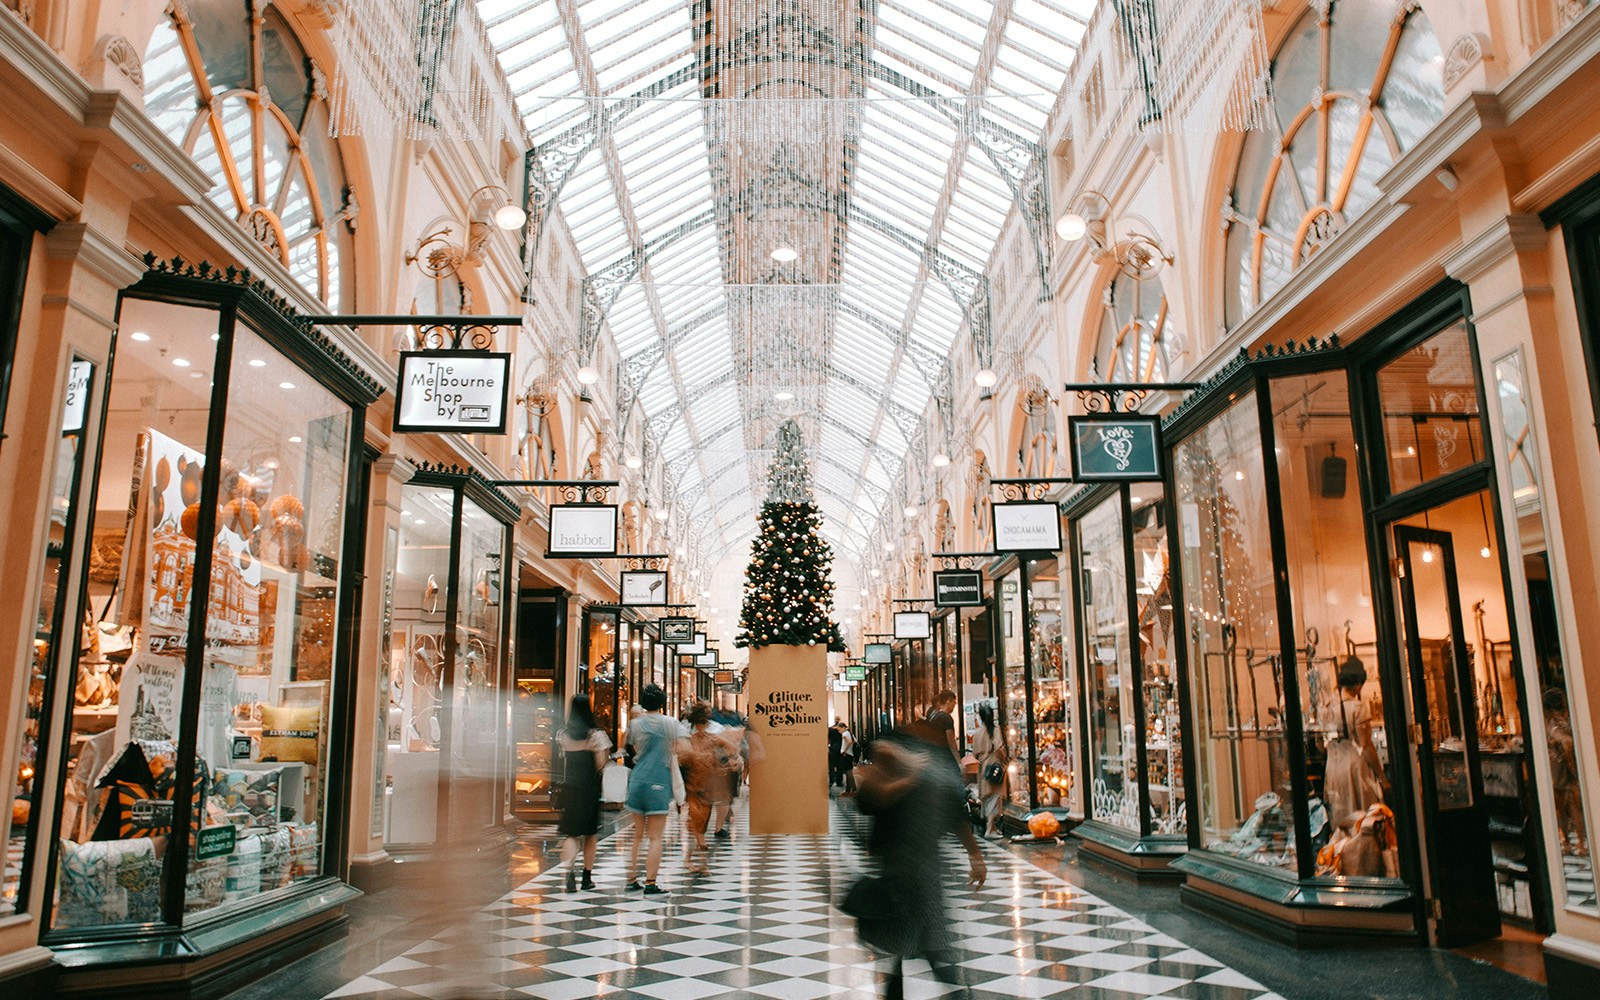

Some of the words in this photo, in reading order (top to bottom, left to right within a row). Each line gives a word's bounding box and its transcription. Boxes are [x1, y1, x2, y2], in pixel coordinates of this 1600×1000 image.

[428, 362, 454, 375] The
[411, 373, 495, 388] Melbourne
[424, 388, 463, 406] Shop
[437, 404, 456, 419] by
[1003, 526, 1048, 535] CHOCAMAMA
[939, 584, 978, 594] WESTMINSTER
[769, 691, 813, 704] Glitter.
[755, 702, 803, 716] Sparkle
